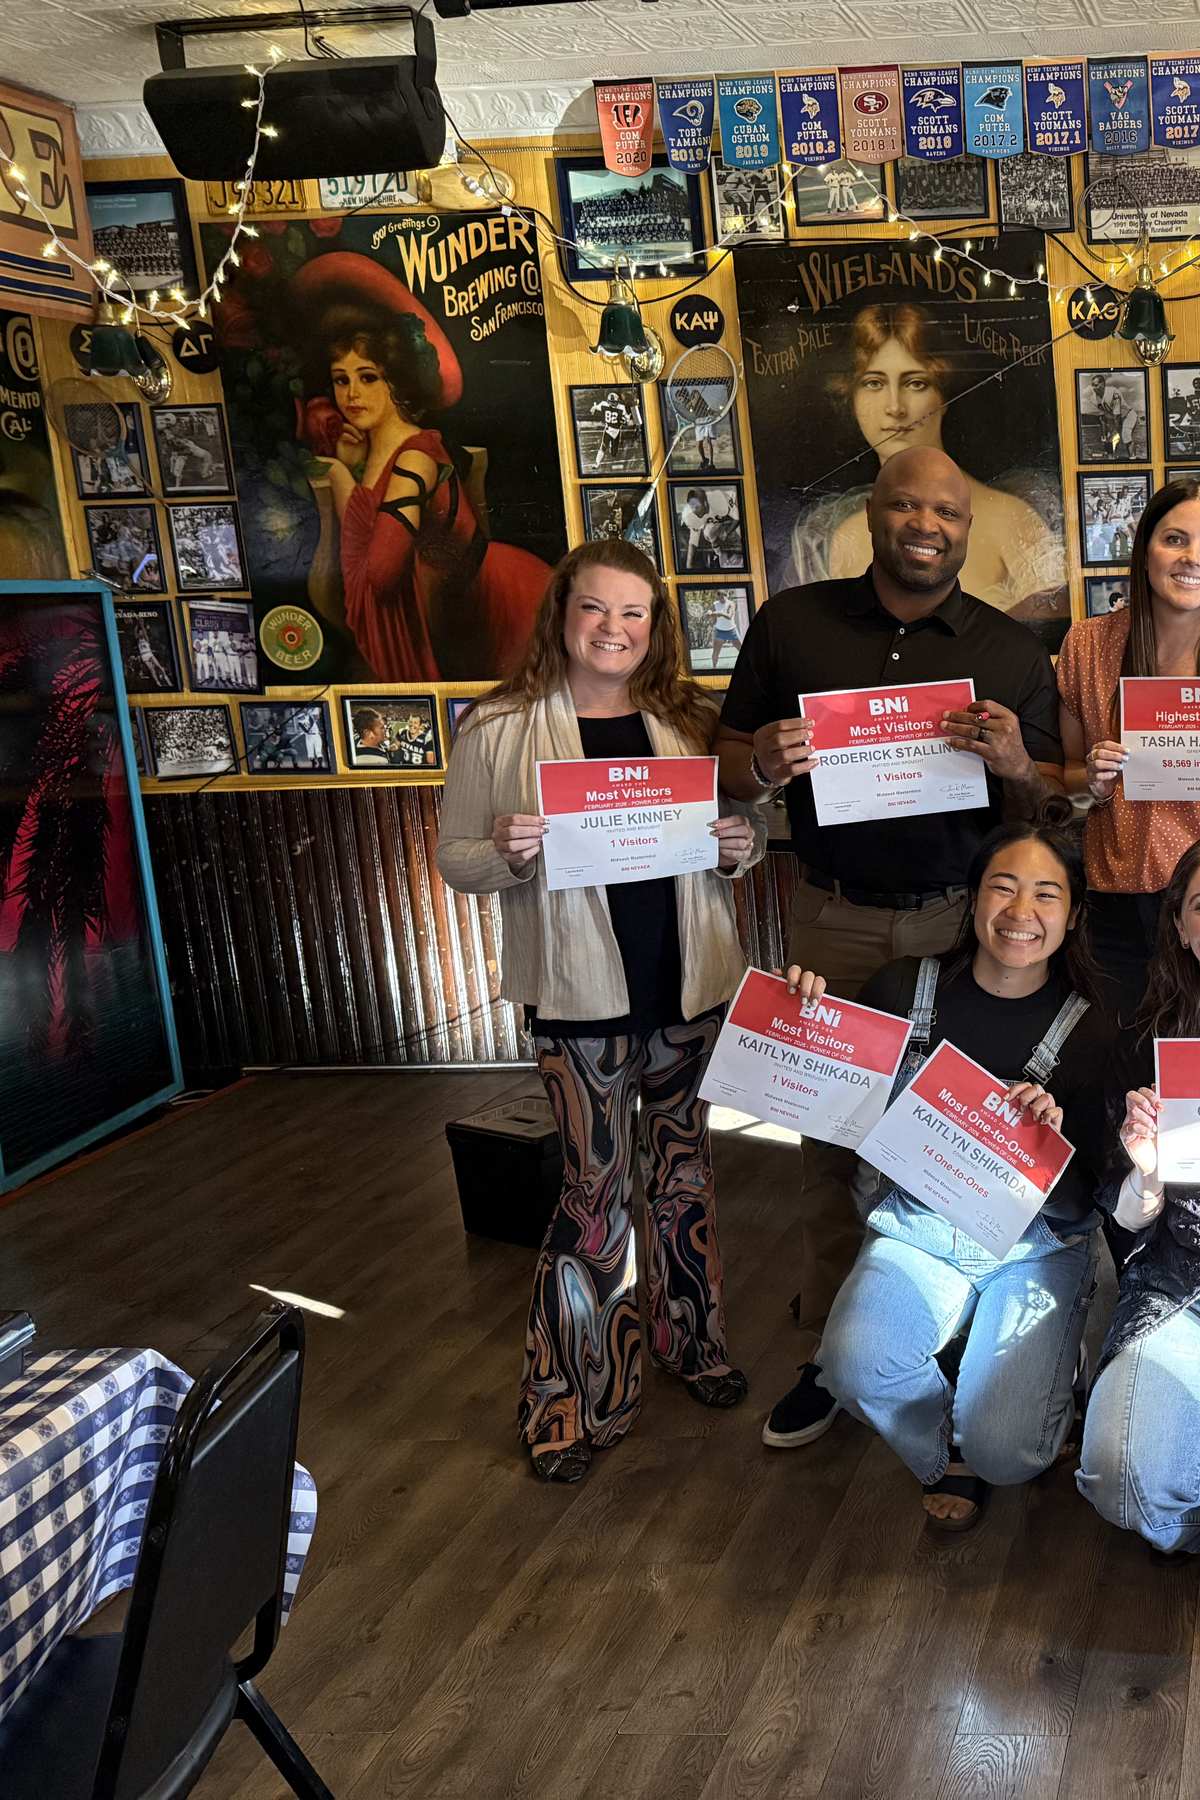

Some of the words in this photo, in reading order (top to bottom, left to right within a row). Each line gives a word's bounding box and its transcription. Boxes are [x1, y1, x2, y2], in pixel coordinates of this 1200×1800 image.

[904, 76, 958, 87] CHAMPIONS
[598, 91, 651, 102] CHAMPIONS
[659, 88, 713, 99] CHAMPIONS
[719, 85, 774, 96] CHAMPIONS
[918, 115, 949, 125] SCOTT
[1040, 110, 1073, 121] SCOTT
[1110, 111, 1130, 121] VAG
[733, 124, 766, 134] CUBAN
[910, 124, 958, 135] YOUMANS
[1033, 119, 1082, 131] YOUMANS
[1098, 120, 1143, 131] BADGERS
[619, 131, 641, 140] COM
[678, 127, 702, 138] TOBY
[1036, 130, 1081, 146] 2017.1
[1104, 130, 1138, 145] 2016
[1165, 124, 1200, 140] 2017
[731, 133, 770, 144] OSTROM
[918, 135, 952, 150] 2018
[974, 134, 1018, 146] 2017.2
[615, 140, 646, 150] PUTER
[853, 139, 896, 151] 2018.1
[616, 151, 647, 164] 2020
[735, 144, 769, 159] 2019
[1160, 210, 1188, 218] Nevada
[387, 218, 426, 233] Greetings
[1154, 219, 1188, 227] Champions
[266, 611, 312, 631] WUNDER
[275, 649, 313, 664] BEER
[1155, 711, 1200, 723] Highest
[849, 723, 881, 737] Most
[883, 719, 933, 733] Visitors
[1140, 736, 1186, 747] TASHA
[818, 749, 892, 767] RODERICK
[1162, 759, 1192, 769] $8,569
[586, 789, 618, 802] Most
[622, 787, 672, 800] Visitors
[580, 814, 623, 830] JULIE
[627, 809, 682, 825] KINNEY
[771, 1016, 802, 1037] Most
[806, 1028, 856, 1053] Visitors
[738, 1034, 800, 1067] KAITLYN
[802, 1057, 871, 1089] SHIKADA
[937, 1088, 969, 1117] Most
[968, 1111, 1037, 1168] One-to-Ones
[912, 1105, 970, 1152] KAITLYN
[970, 1149, 1028, 1198] SHIKADA
